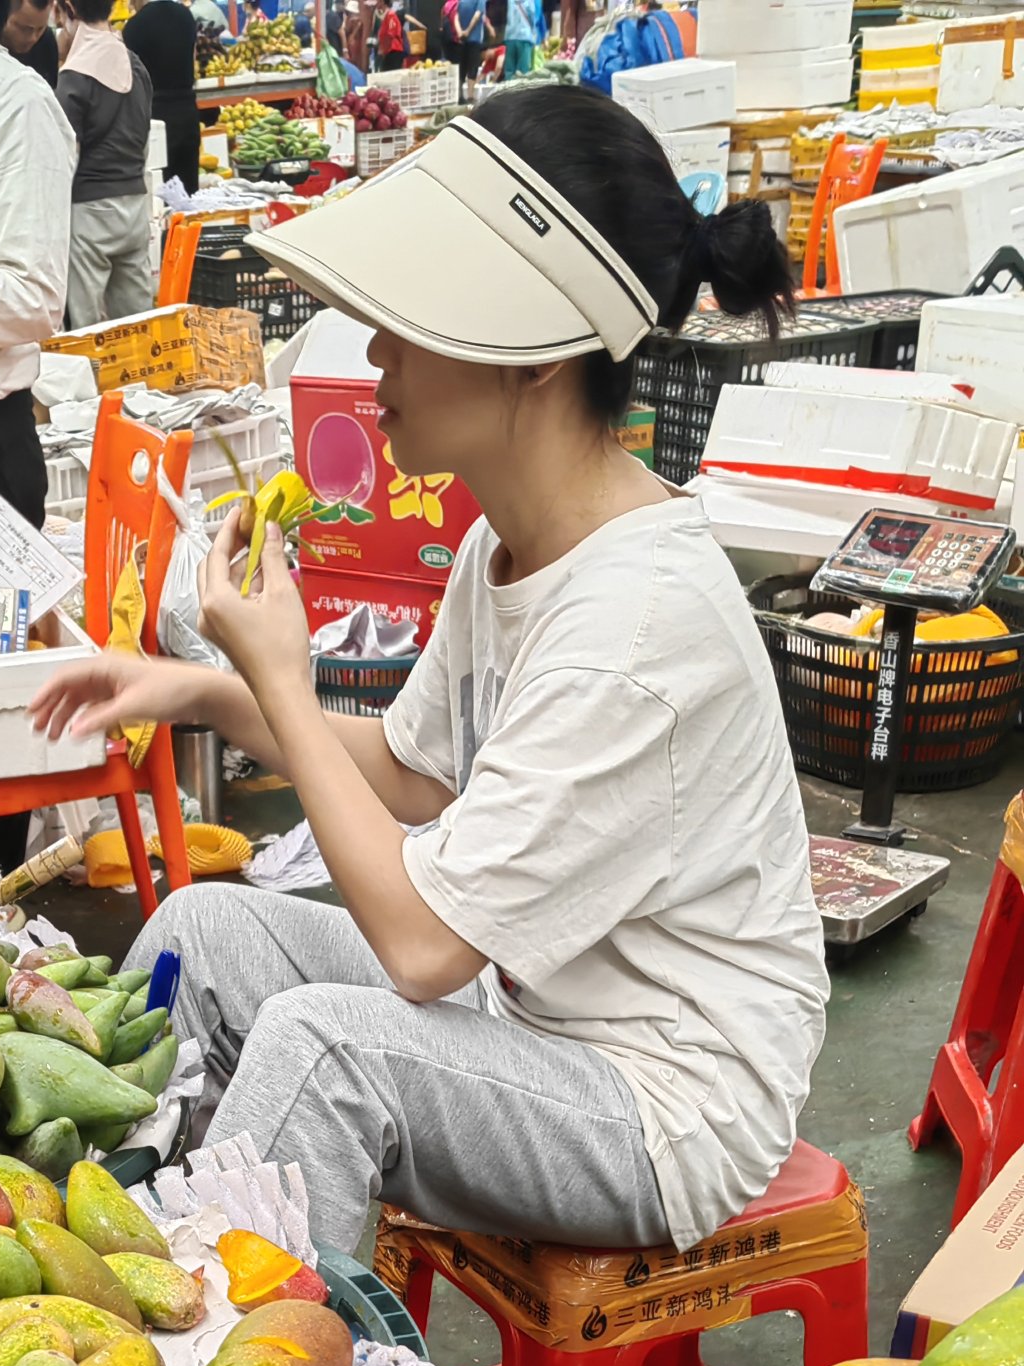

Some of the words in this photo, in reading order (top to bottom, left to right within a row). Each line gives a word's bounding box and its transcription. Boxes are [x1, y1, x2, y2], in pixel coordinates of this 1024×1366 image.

[870, 631, 900, 762] 香山牌电子台秤
[657, 1230, 782, 1278] 三亚新鸿港
